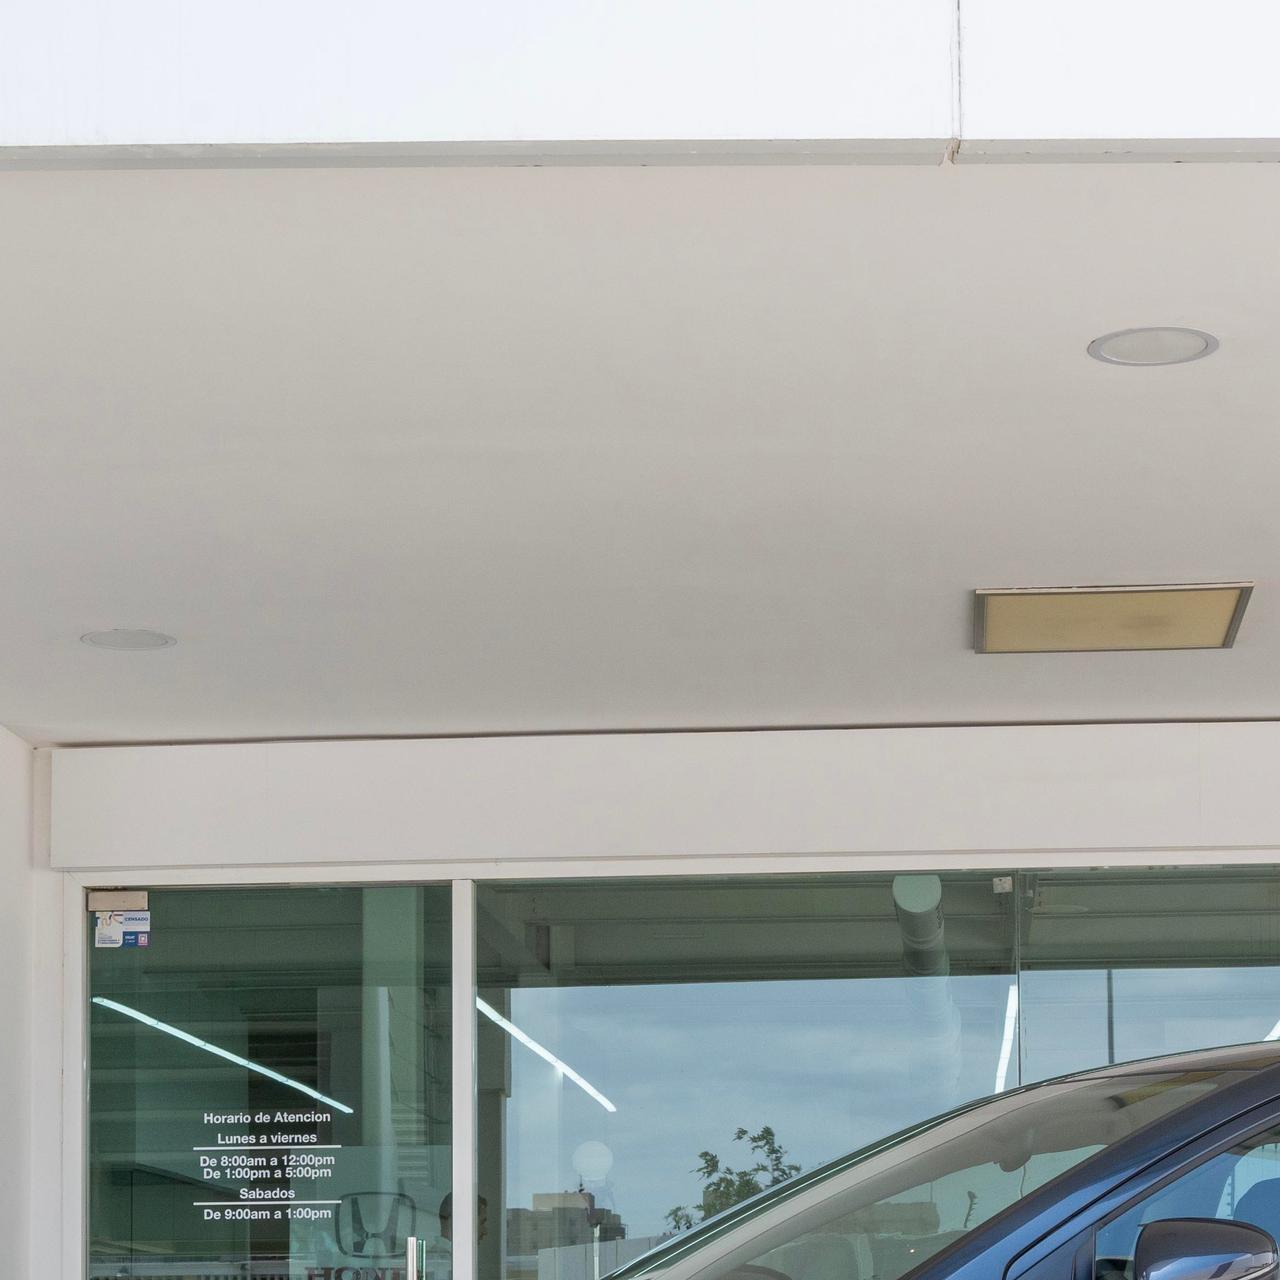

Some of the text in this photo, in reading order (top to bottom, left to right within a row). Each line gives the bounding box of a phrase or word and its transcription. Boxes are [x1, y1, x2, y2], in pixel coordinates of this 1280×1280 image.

[203, 1112, 331, 1124] Horario de Atencion
[217, 1132, 317, 1144] Lunes a viernes
[200, 1154, 335, 1167] De 8:00am a 12:00pm
[203, 1167, 332, 1180] De 1:00pm a 5:00pm
[239, 1188, 295, 1199] Sabados
[203, 1208, 332, 1220] De 9:00am a 1:00pm
